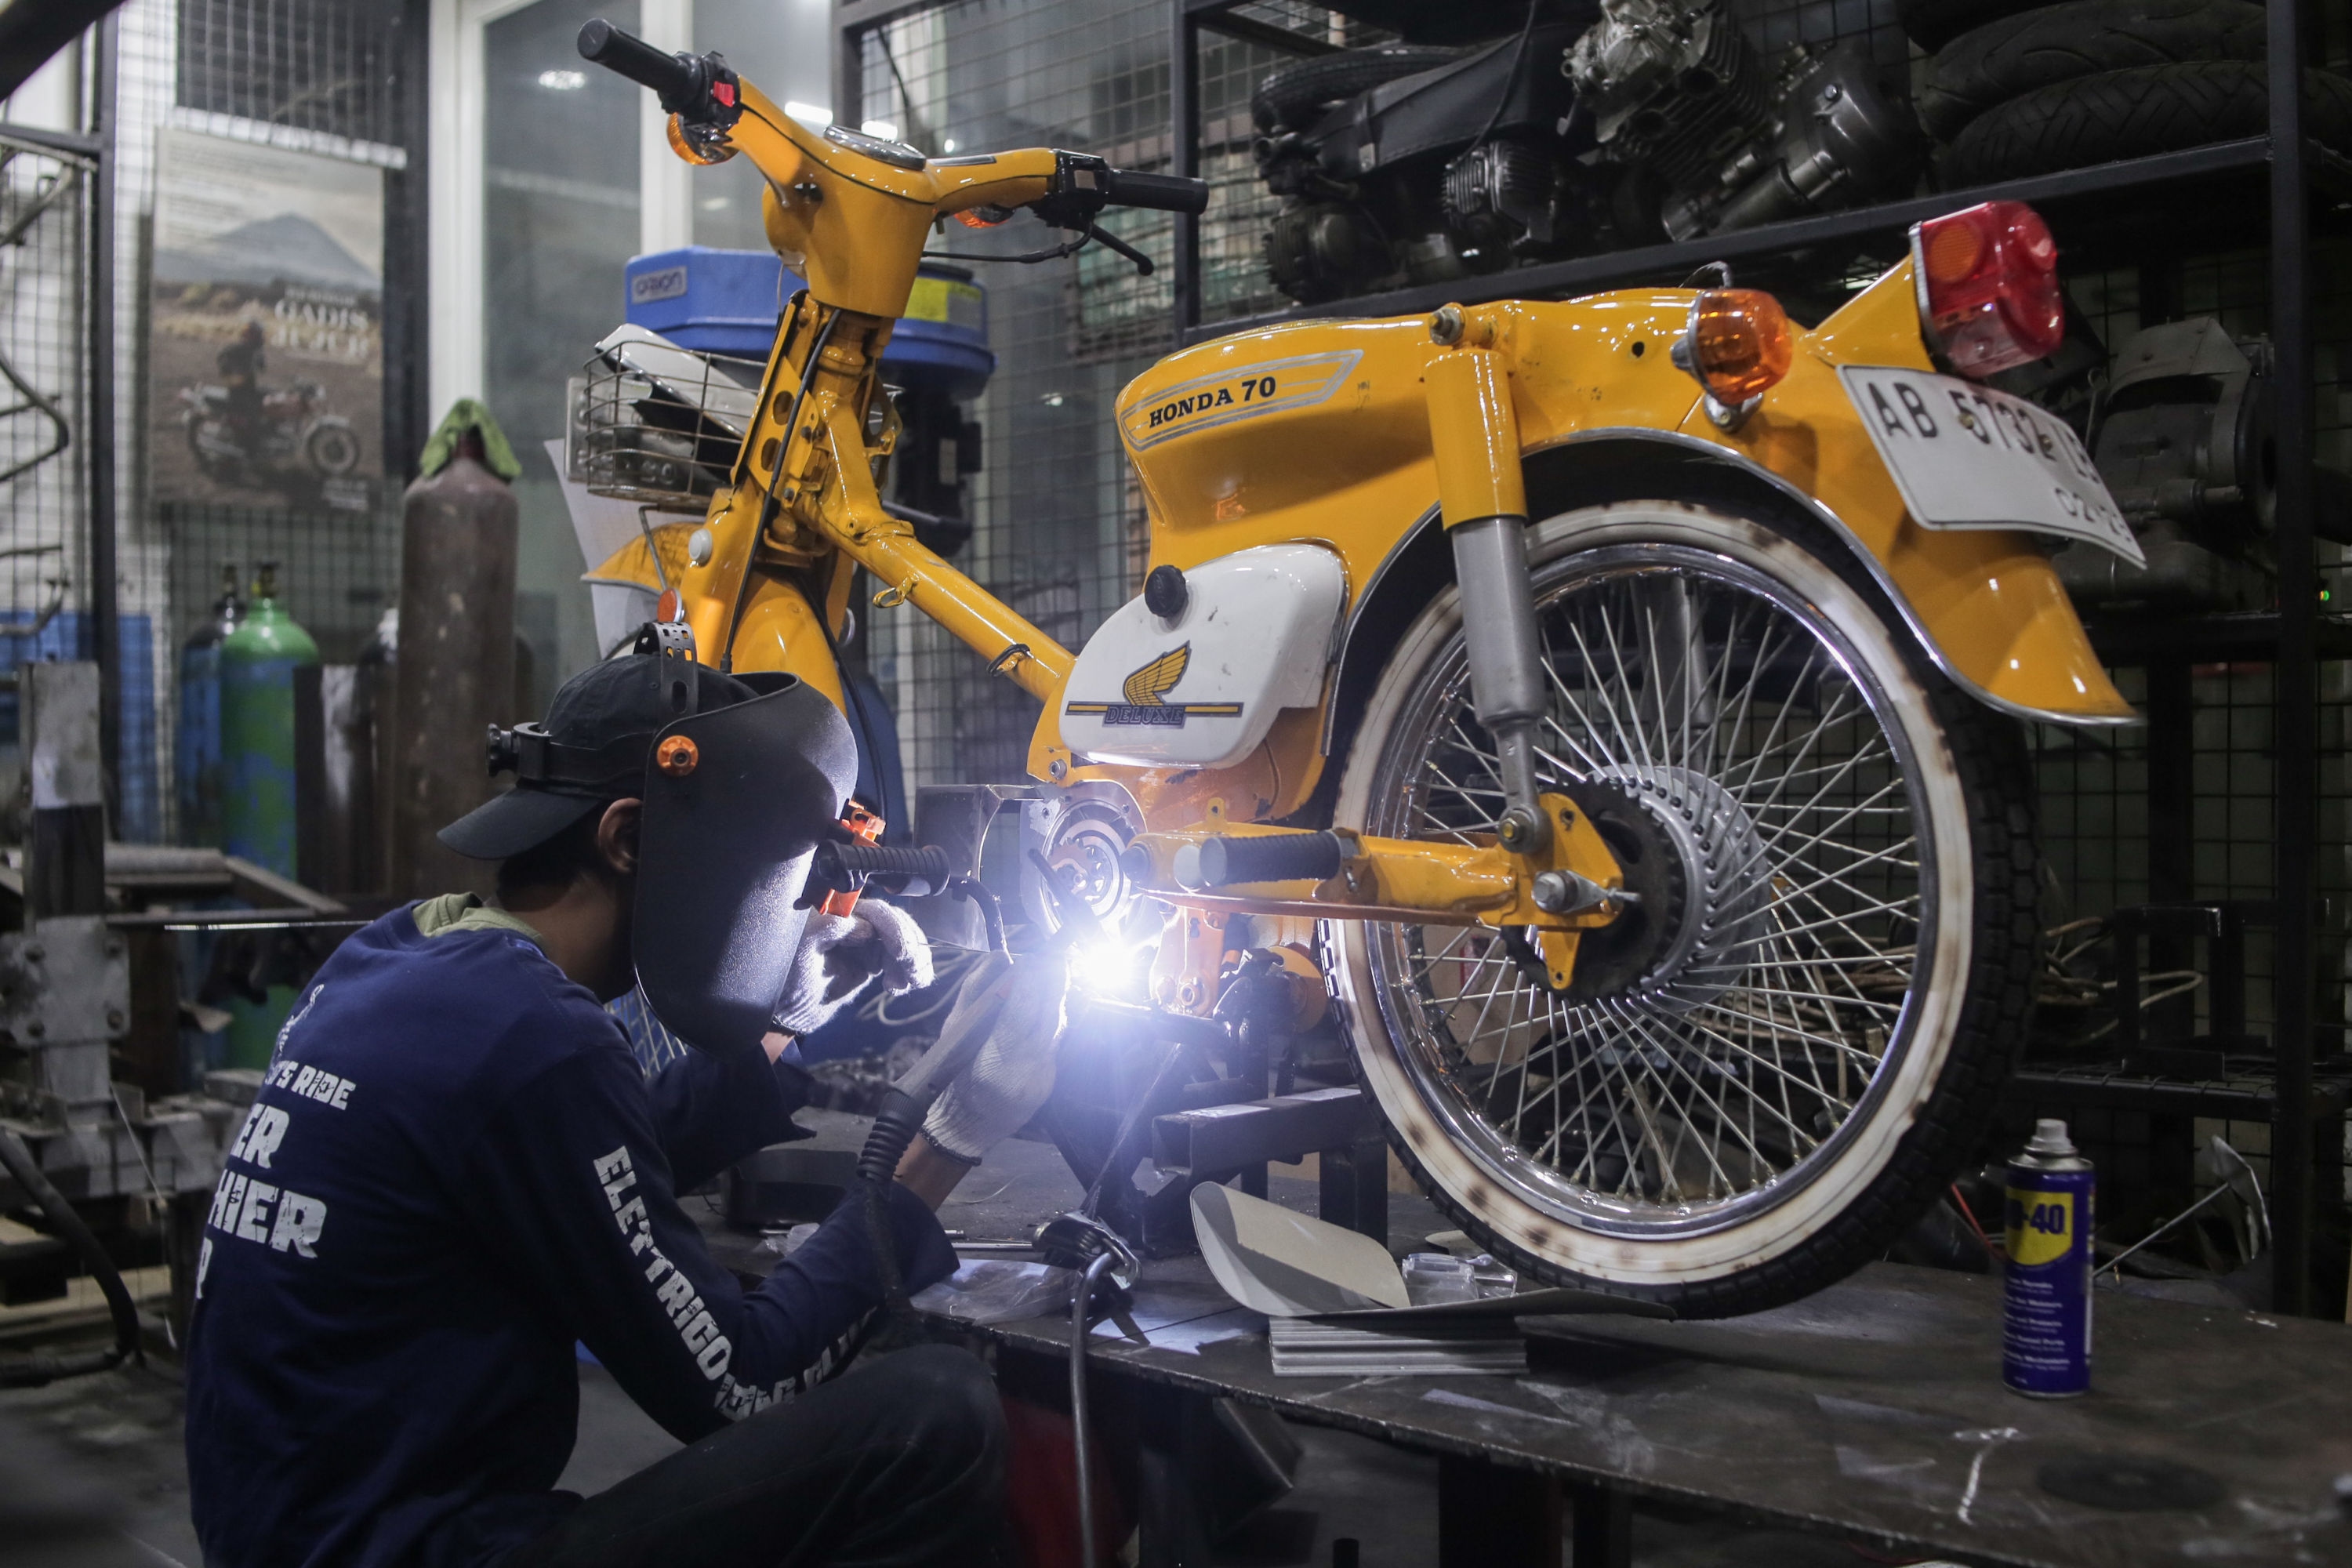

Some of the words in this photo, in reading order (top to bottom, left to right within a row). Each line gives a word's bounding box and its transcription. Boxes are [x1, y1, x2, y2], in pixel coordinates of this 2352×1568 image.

[1149, 388, 1235, 428] HONDA
[1241, 376, 1276, 402] 70
[1868, 382, 1938, 439] AB
[1948, 389, 2056, 461] 5732
[1104, 706, 1185, 725] DELUXE
[291, 1064, 357, 1111] RIDE
